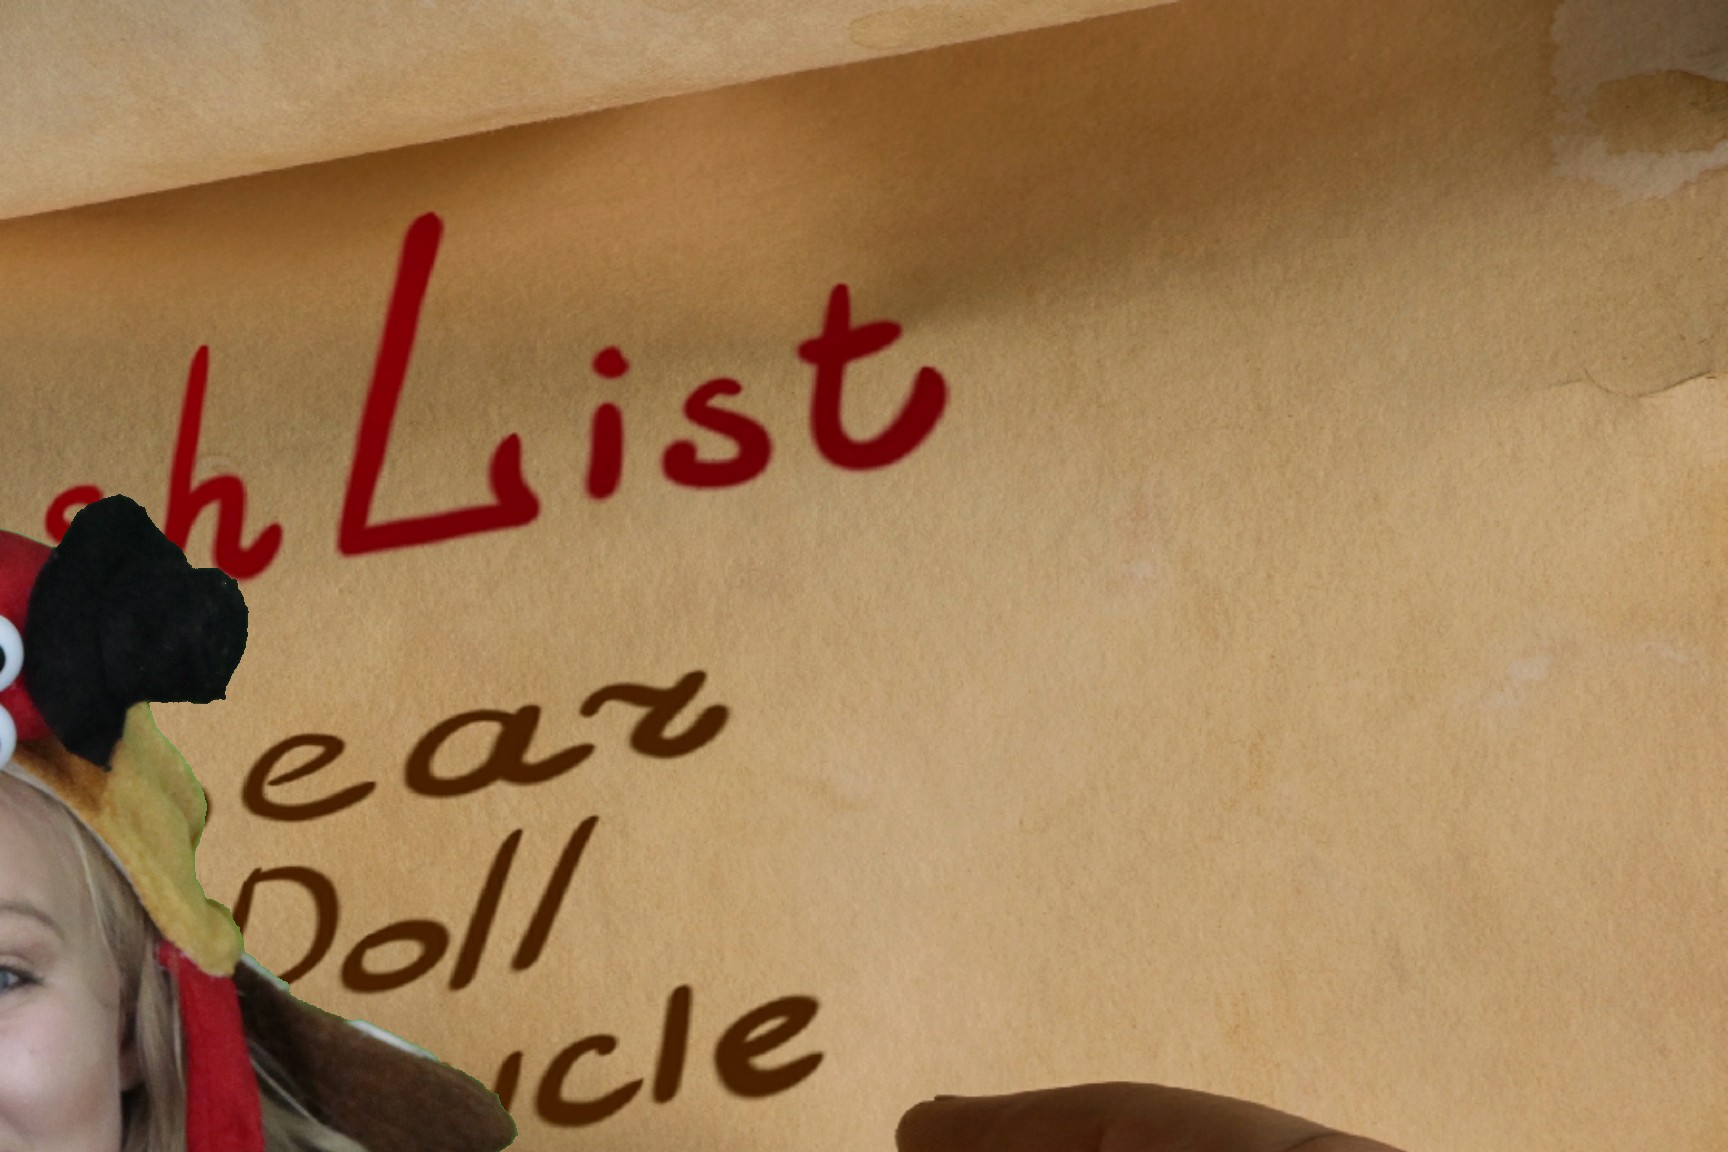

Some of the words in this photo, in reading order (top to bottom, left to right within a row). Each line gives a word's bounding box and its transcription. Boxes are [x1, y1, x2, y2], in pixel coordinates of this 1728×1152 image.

[338, 212, 949, 556] List
[204, 671, 729, 822] ear
[231, 814, 600, 994] Doll
